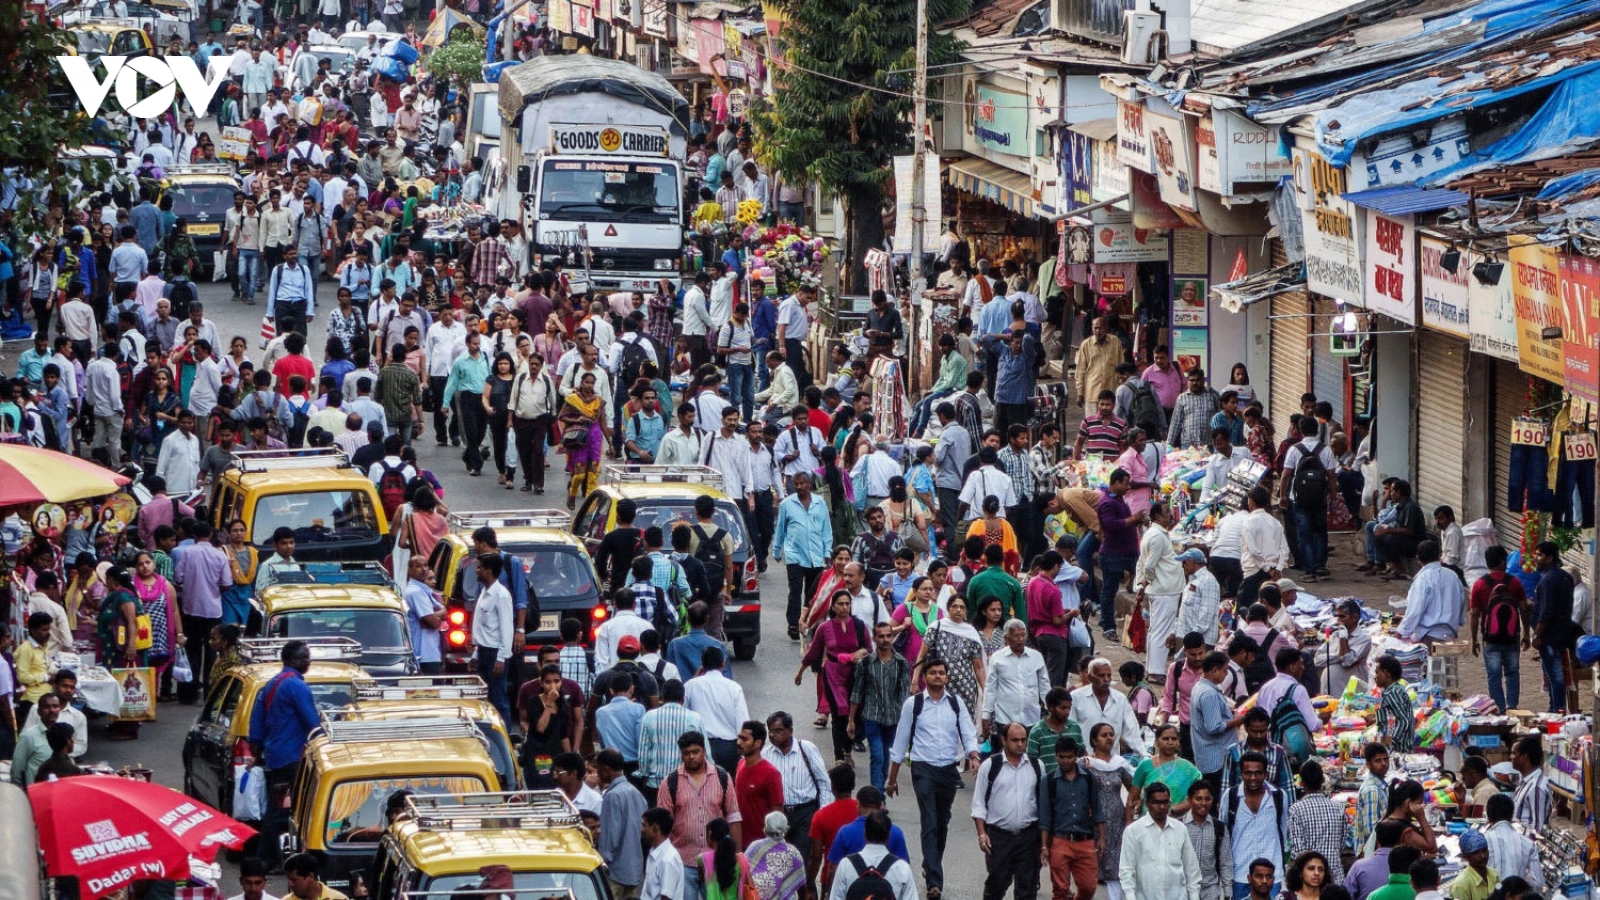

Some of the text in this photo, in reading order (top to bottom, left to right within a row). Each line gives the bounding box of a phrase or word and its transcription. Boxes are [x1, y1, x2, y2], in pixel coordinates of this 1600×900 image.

[560, 130, 600, 149] GOODS
[623, 132, 665, 152] CARRIER
[1110, 283, 1124, 291] 170
[1514, 428, 1544, 445] 190
[1567, 443, 1595, 459] 190
[71, 834, 149, 861] SUVIDHA
[87, 866, 137, 894] Dadar
